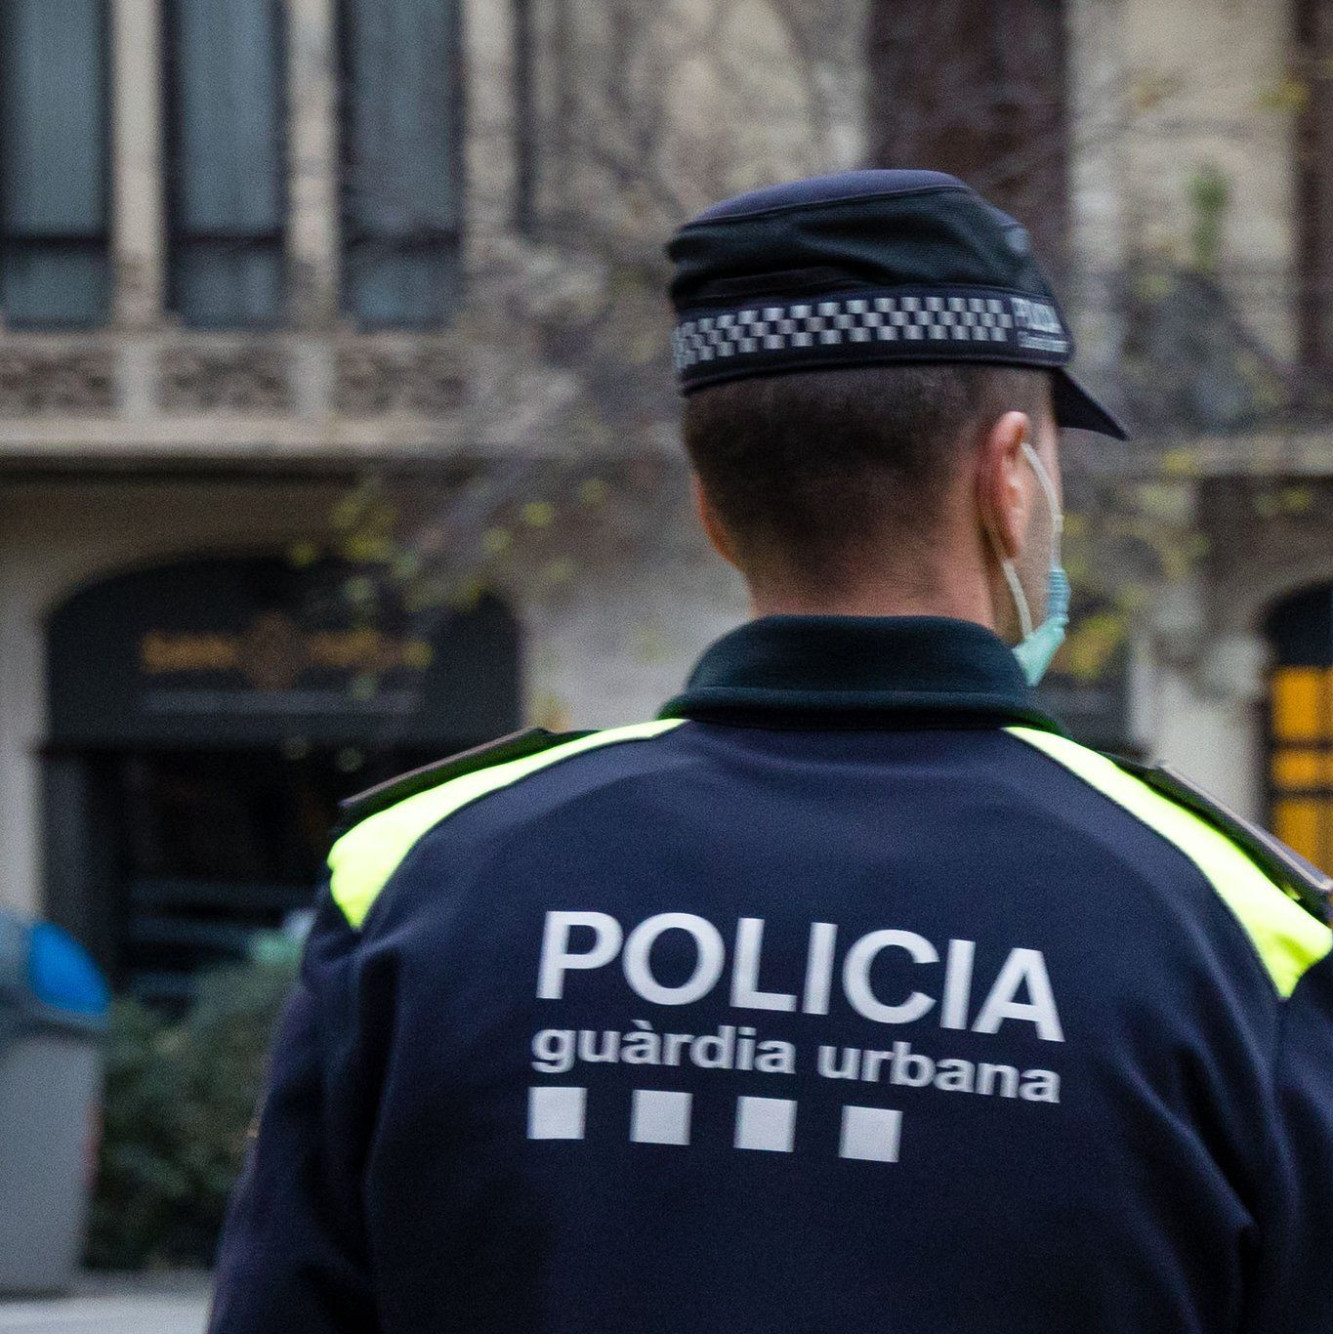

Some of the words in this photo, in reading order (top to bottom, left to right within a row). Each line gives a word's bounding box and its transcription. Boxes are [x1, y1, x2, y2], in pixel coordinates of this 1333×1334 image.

[537, 910, 1064, 1043] POLICIA
[531, 1020, 796, 1074] guàrdia
[816, 1040, 1061, 1103] urbana
